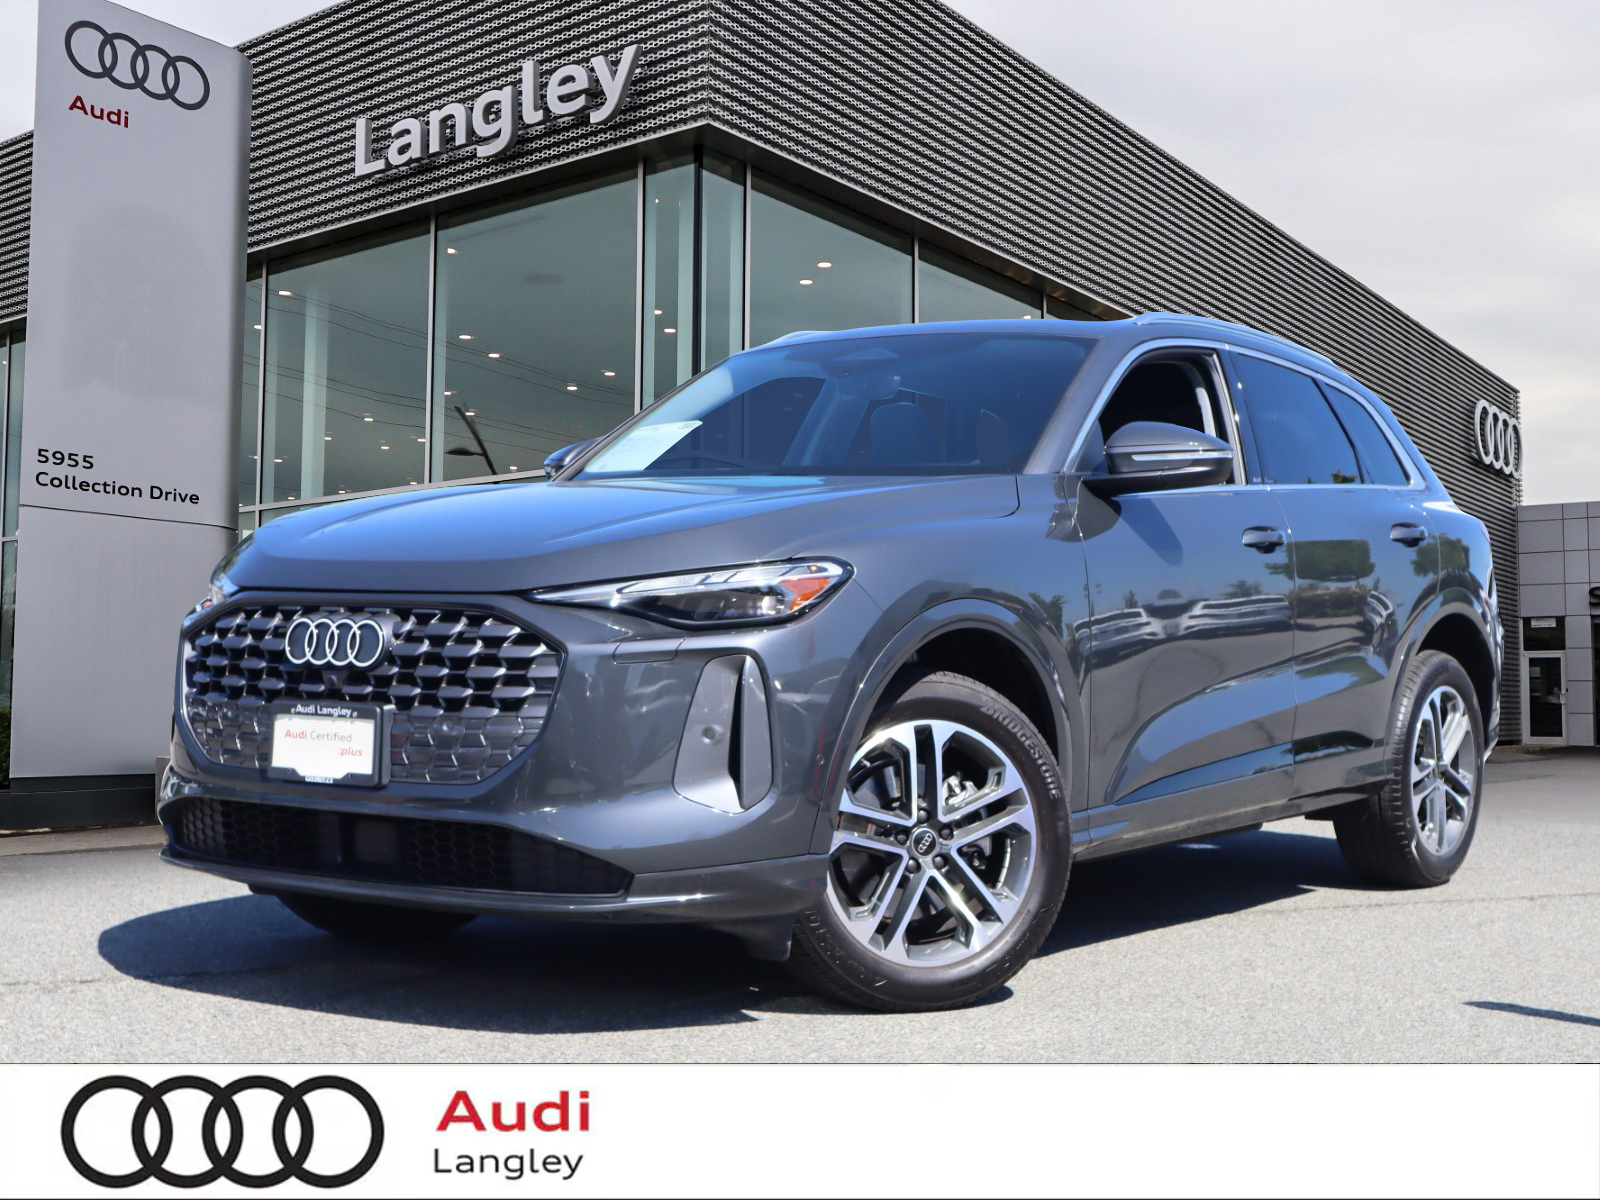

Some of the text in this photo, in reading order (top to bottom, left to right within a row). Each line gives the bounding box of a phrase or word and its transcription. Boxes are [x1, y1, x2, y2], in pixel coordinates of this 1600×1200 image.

[68, 95, 129, 128] Audi
[355, 44, 643, 177] Langley
[37, 448, 94, 469] 5955
[35, 472, 200, 504] Collection Drive
[295, 703, 352, 718] Audi Langley
[284, 729, 352, 743] Audi Certified
